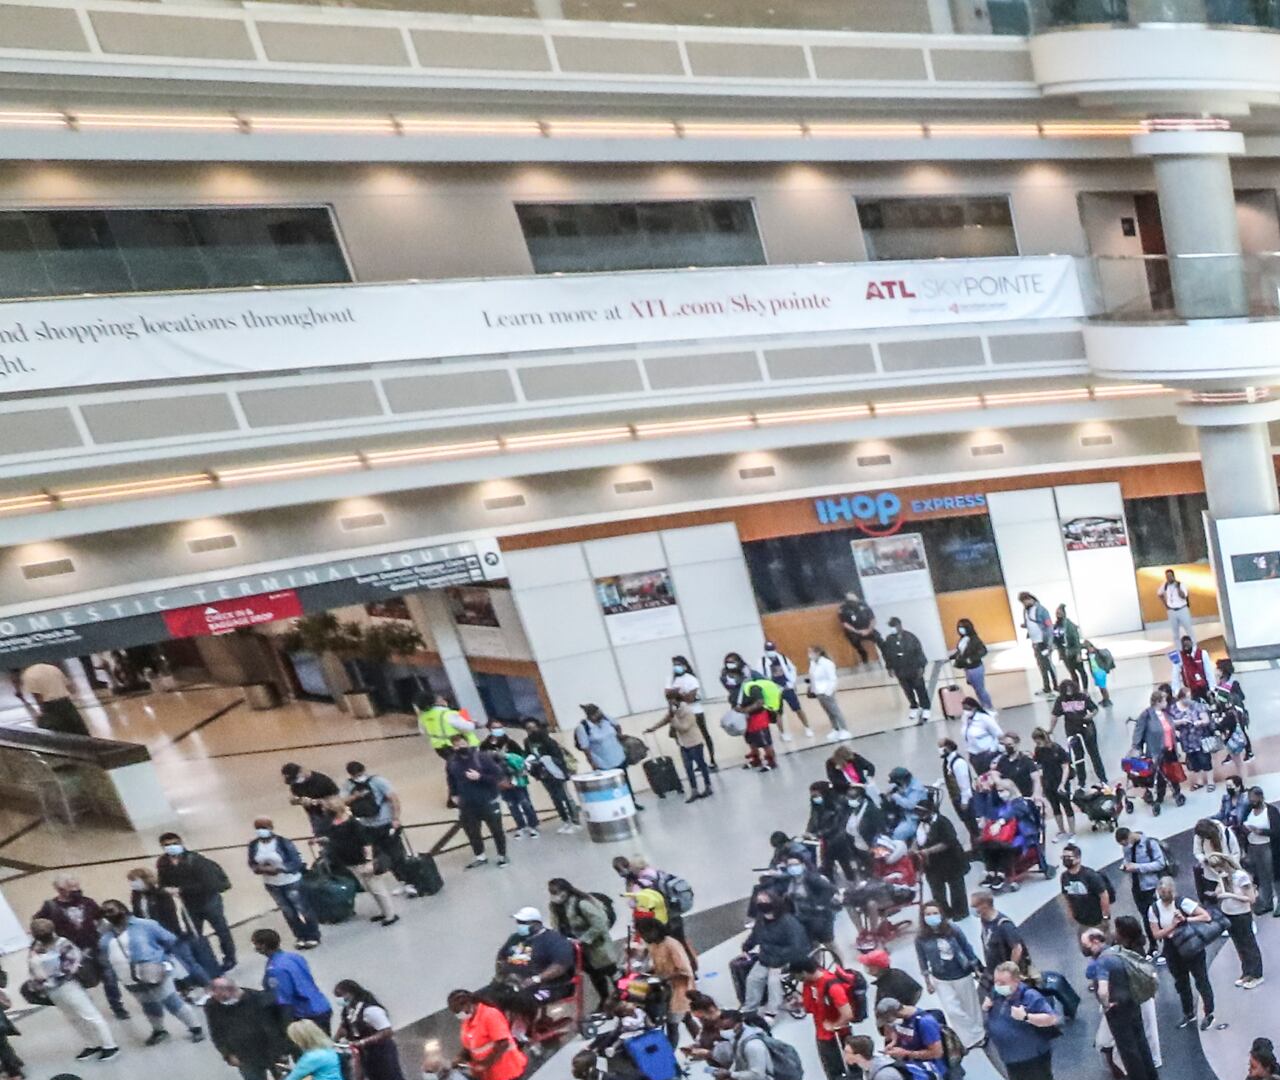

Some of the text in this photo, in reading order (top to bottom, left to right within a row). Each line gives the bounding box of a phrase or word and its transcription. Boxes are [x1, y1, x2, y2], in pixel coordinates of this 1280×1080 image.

[865, 273, 1046, 301] ATL SKYPOINTE
[0, 307, 356, 344] nd shopping locations throughout
[482, 309, 544, 329] Learn
[549, 309, 598, 325] more
[604, 306, 622, 321] at
[815, 491, 987, 525] IHOP EXPRESS
[0, 594, 169, 636] OMESTIC
[194, 564, 361, 603] TERMINAL
[382, 541, 476, 569] SOUTH
